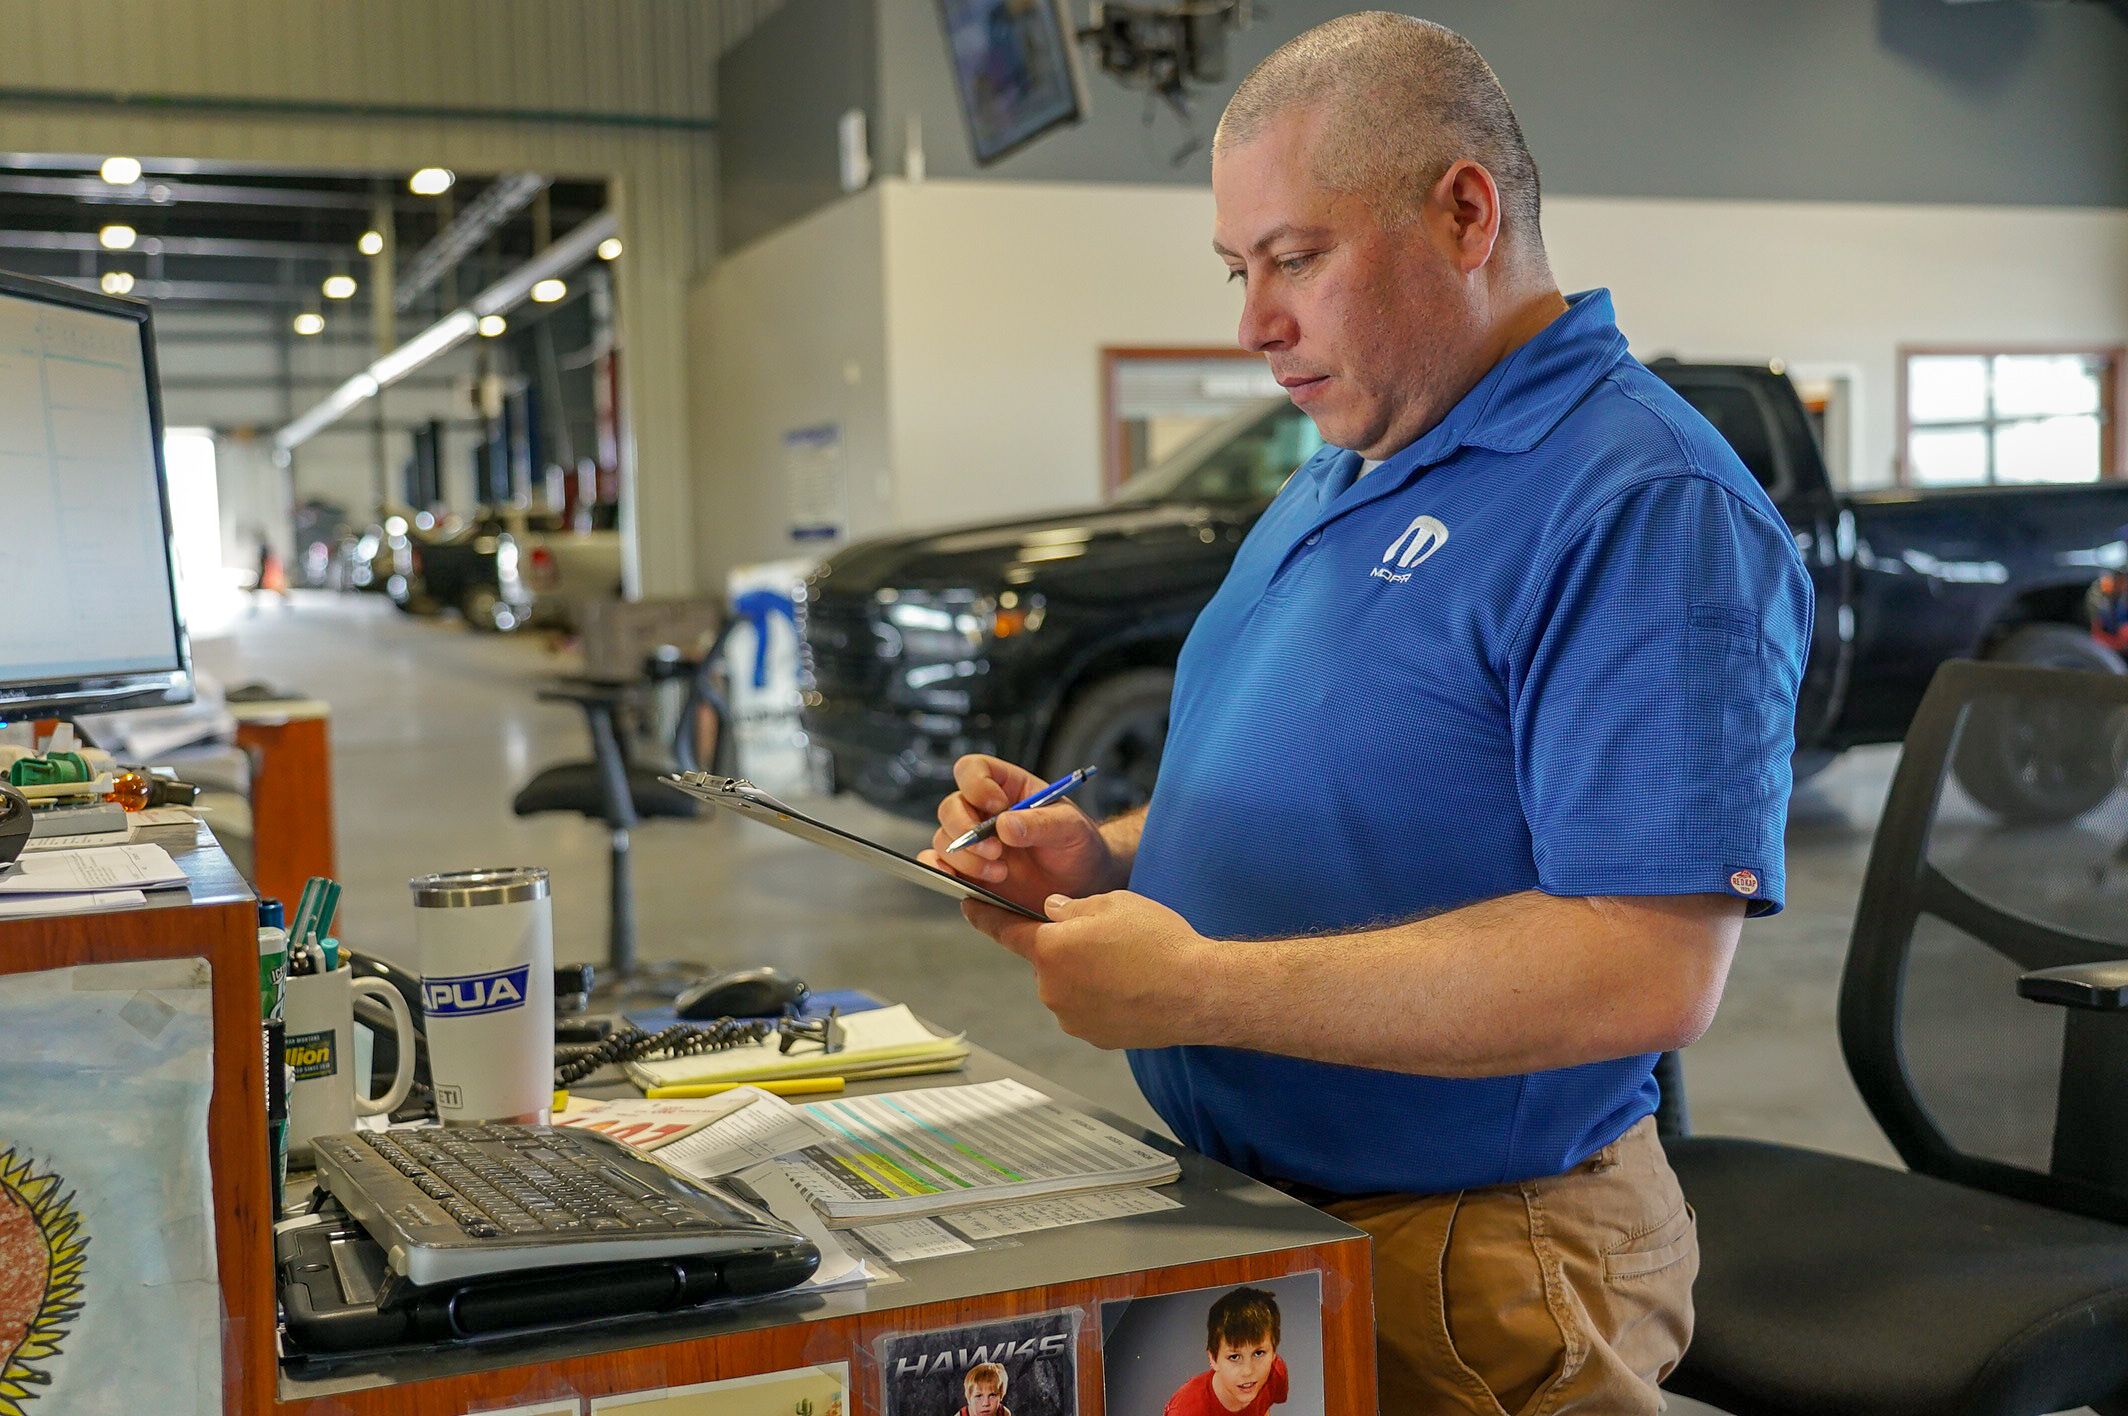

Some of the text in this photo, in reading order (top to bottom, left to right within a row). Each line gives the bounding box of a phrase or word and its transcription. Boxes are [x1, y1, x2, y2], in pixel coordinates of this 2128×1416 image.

[285, 1046, 330, 1066] llion
[438, 1090, 458, 1105] ETI
[895, 1333, 1068, 1378] HAWKS
